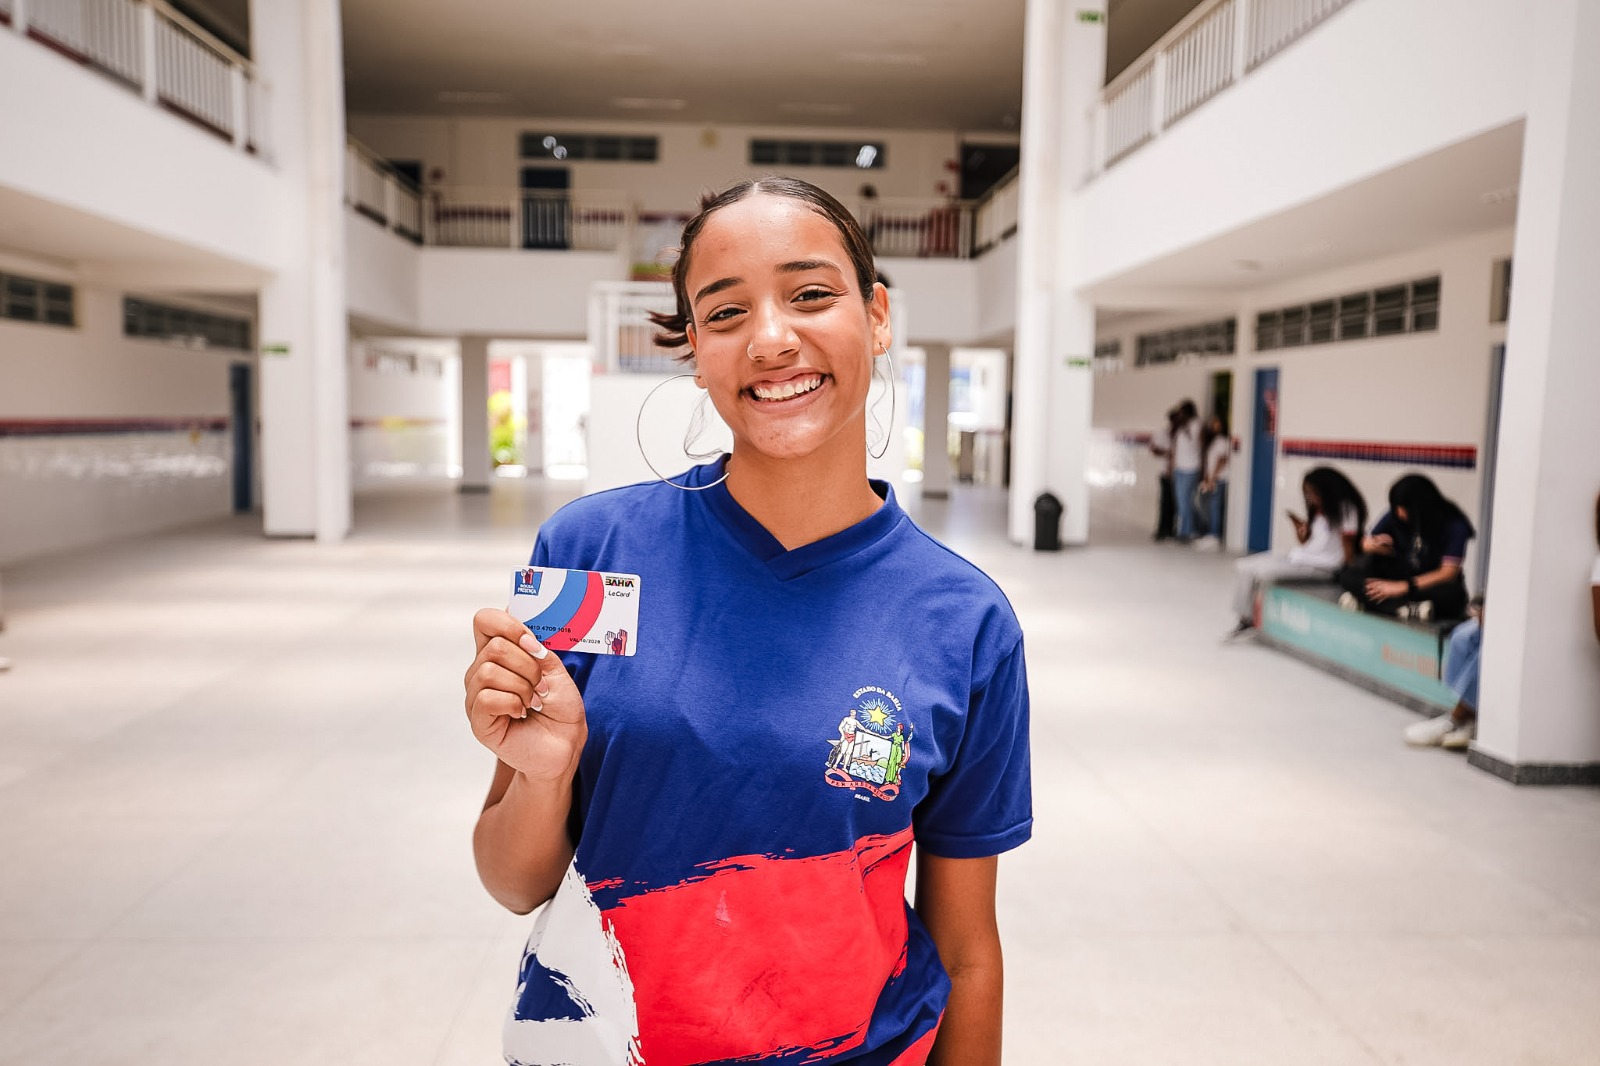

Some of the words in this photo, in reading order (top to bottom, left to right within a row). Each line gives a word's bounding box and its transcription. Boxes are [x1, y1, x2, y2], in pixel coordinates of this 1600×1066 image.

[605, 579, 634, 588] BAHIA
[608, 590, 631, 598] LeCard
[852, 685, 876, 699] ESTADO
[876, 687, 886, 695] DA
[885, 691, 903, 712] BAHIA
[854, 793, 871, 803] BRASIL
